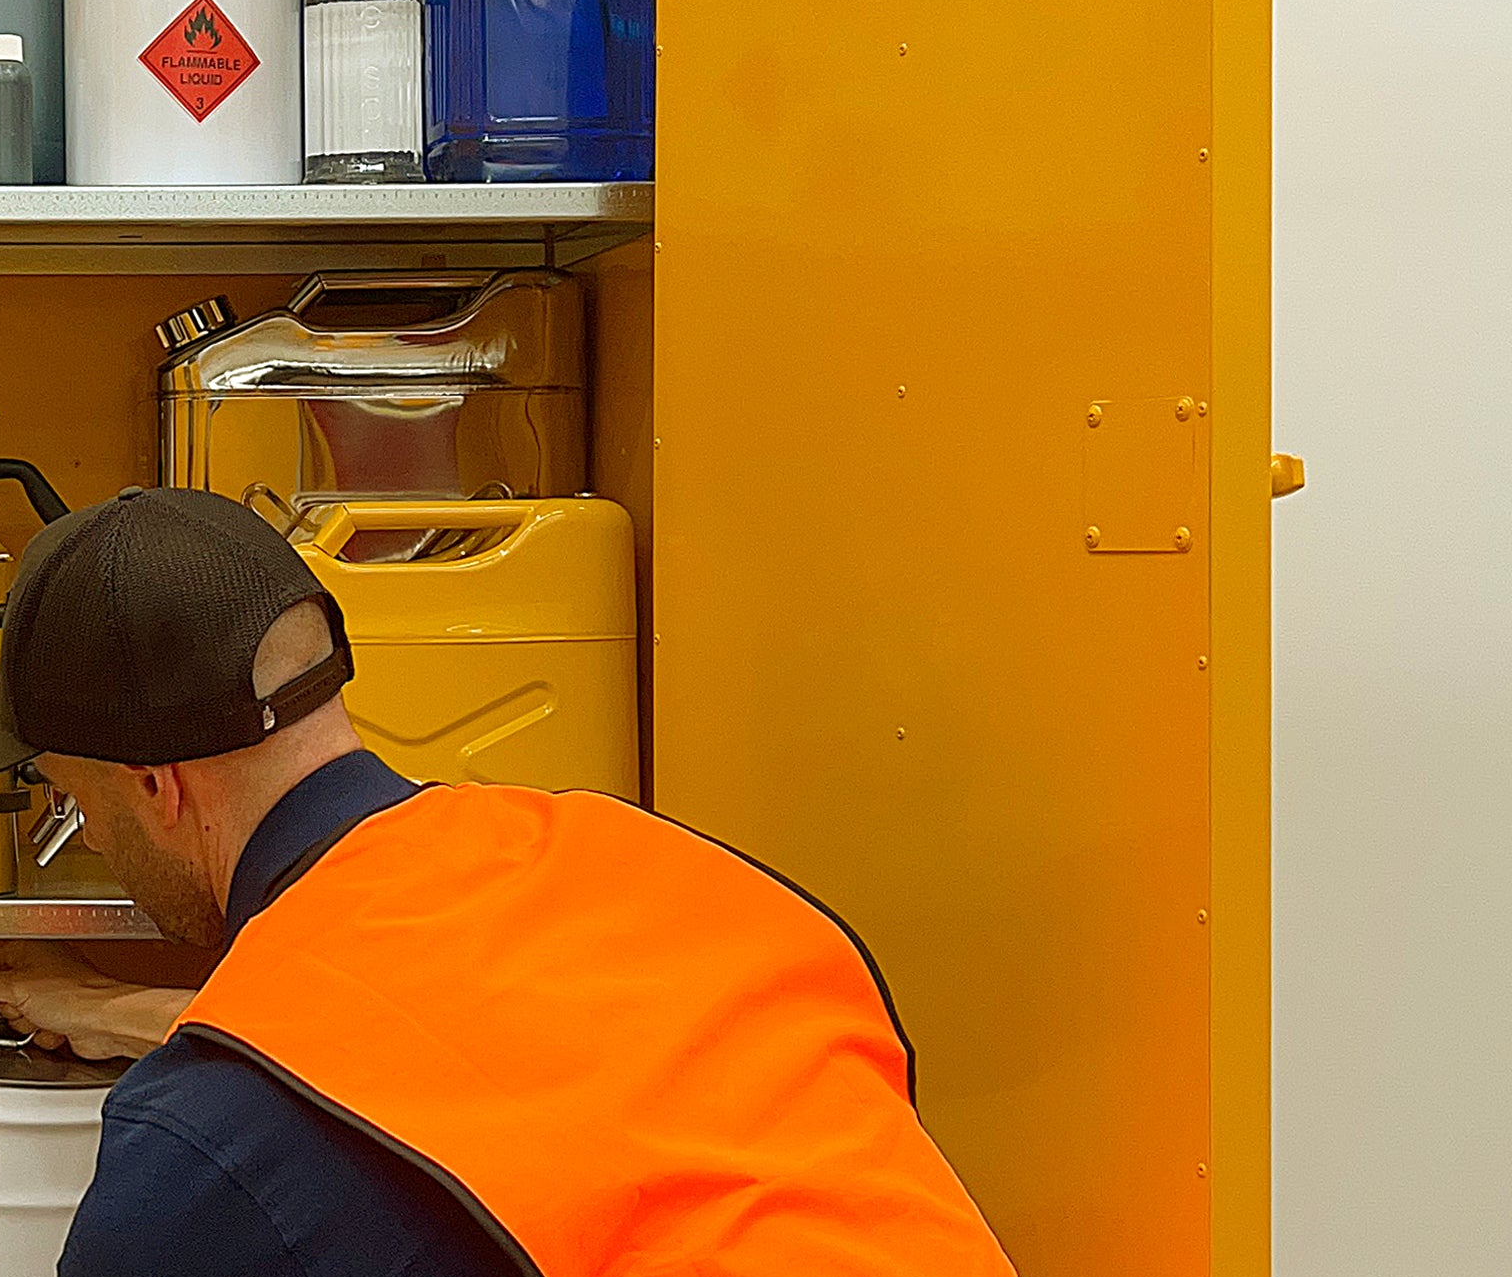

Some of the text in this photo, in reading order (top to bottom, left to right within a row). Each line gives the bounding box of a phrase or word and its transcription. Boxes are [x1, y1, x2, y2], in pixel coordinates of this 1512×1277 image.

[161, 56, 241, 71] FLAMMABLE
[180, 73, 223, 85] LIQUID
[196, 97, 204, 110] 3
